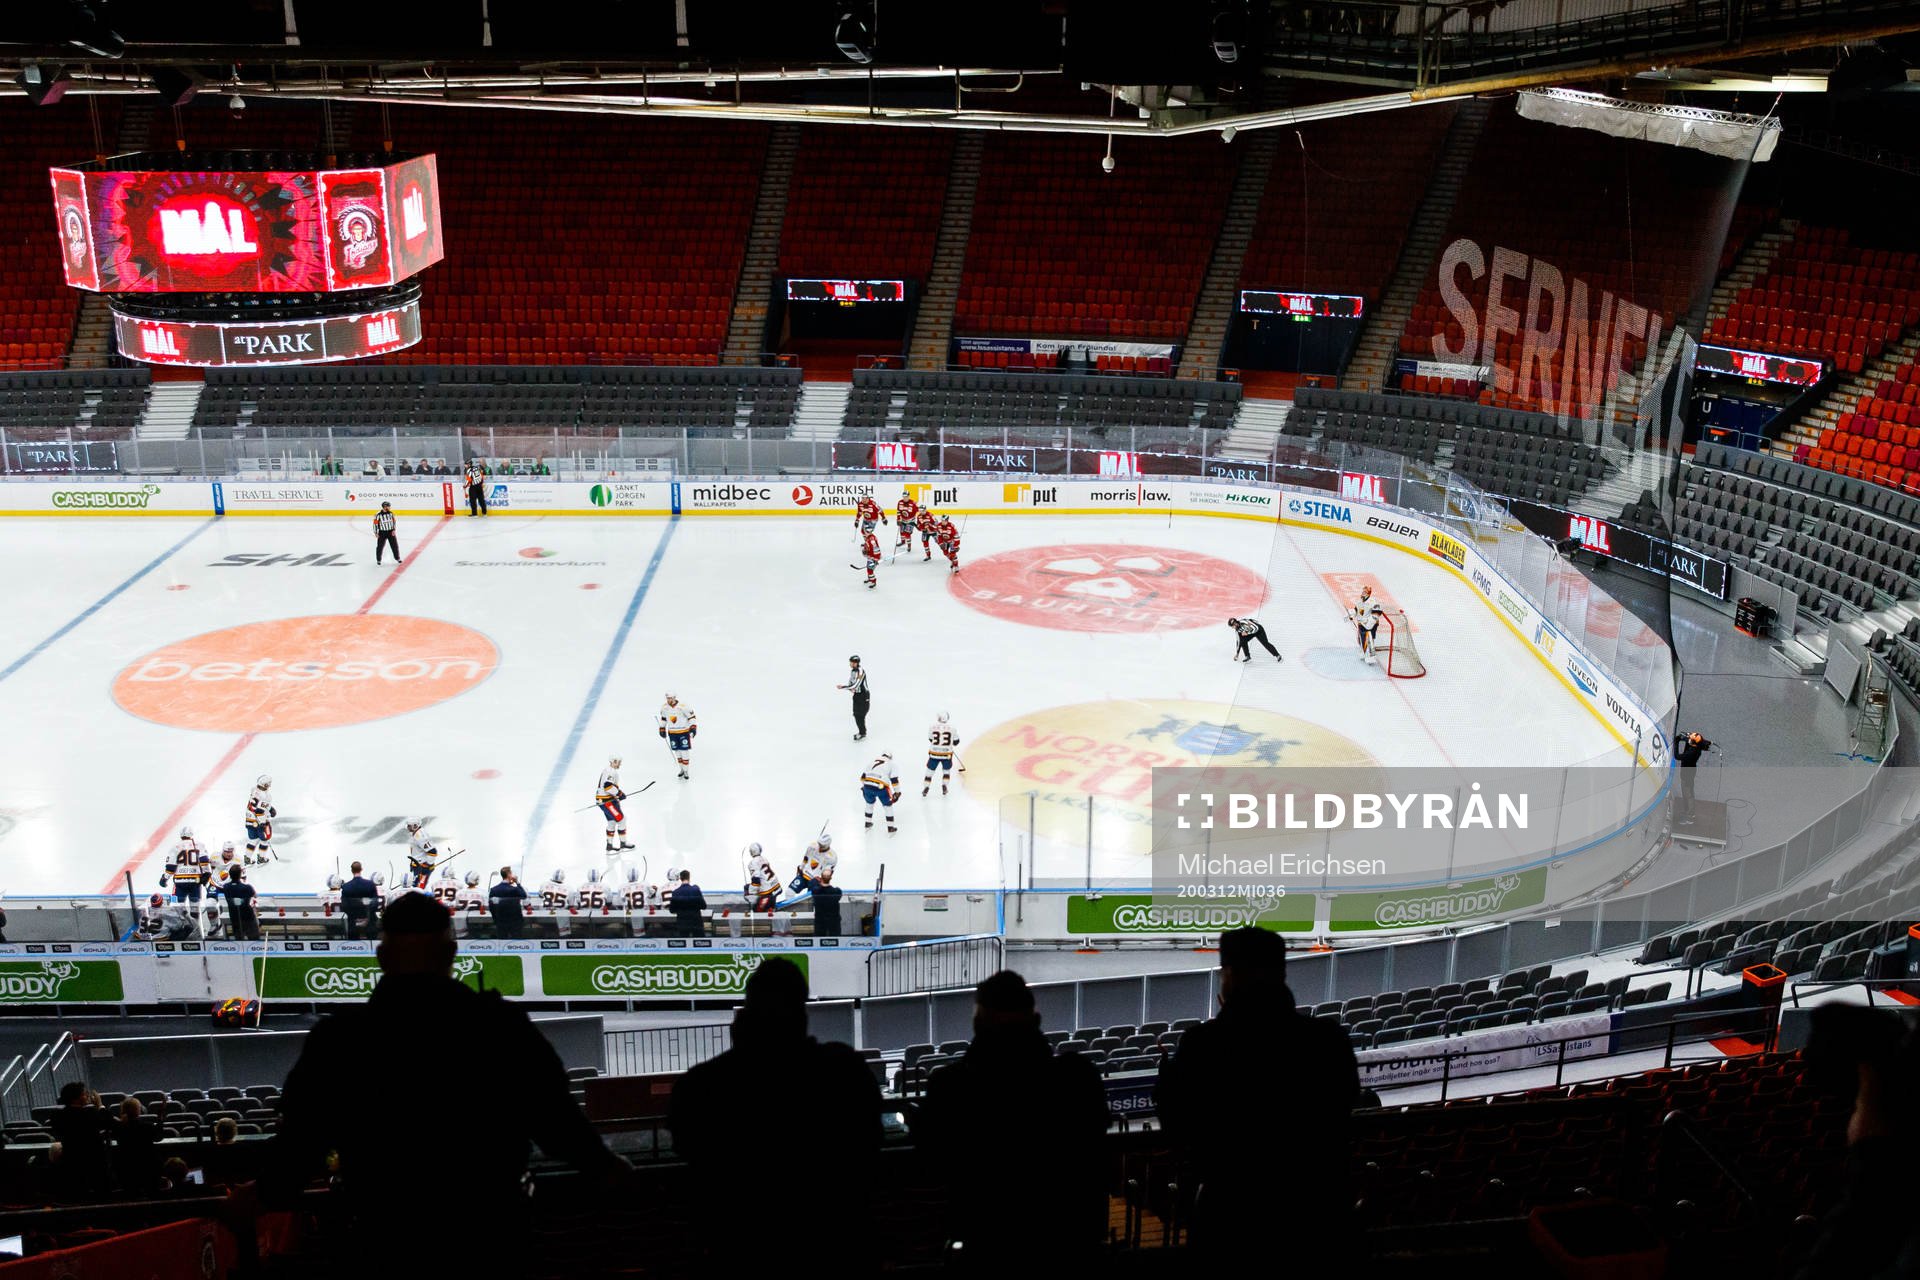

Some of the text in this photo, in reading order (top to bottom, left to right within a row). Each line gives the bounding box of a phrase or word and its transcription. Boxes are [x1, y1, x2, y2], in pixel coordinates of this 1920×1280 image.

[233, 491, 323, 499] TRAVEL SERVICE
[693, 485, 771, 501] midbec
[819, 486, 874, 495] TURKISH
[54, 493, 149, 507] CASHBUDDY
[819, 496, 874, 506] AIRLIN
[1303, 501, 1352, 523] STENA
[211, 553, 354, 567] SHL
[1472, 568, 1492, 596] KPMG
[970, 589, 1180, 627] BAUHAUS
[128, 657, 481, 683] betsson
[1567, 657, 1598, 694] TUVEON
[1605, 693, 1643, 739] VOLVIA
[931, 731, 952, 746] 33
[176, 849, 200, 866] 40
[580, 891, 604, 908] 56
[1380, 891, 1504, 922] CASHBUDDY
[1118, 909, 1257, 928] CASHBUDDY
[597, 969, 745, 988] CASHBUDDY
